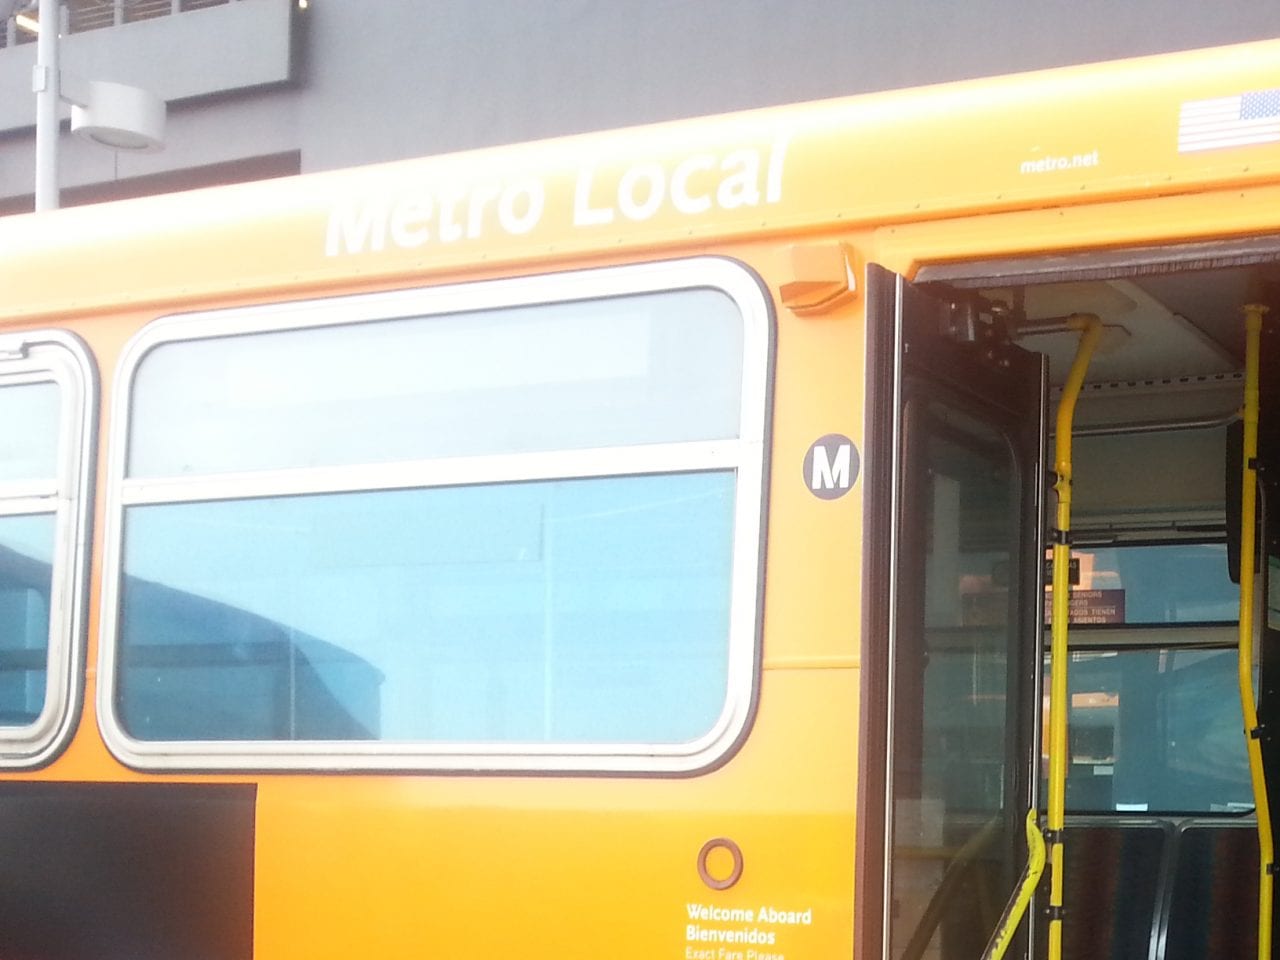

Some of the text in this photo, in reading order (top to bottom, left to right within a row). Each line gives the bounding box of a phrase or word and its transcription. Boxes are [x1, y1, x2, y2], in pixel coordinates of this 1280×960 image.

[1020, 149, 1100, 175] metro.net
[325, 130, 794, 258] Metro Local
[812, 445, 850, 490] M
[686, 903, 813, 925] Welcome Aboard
[686, 924, 776, 945] Bienvenidos
[685, 946, 716, 960] Exact
